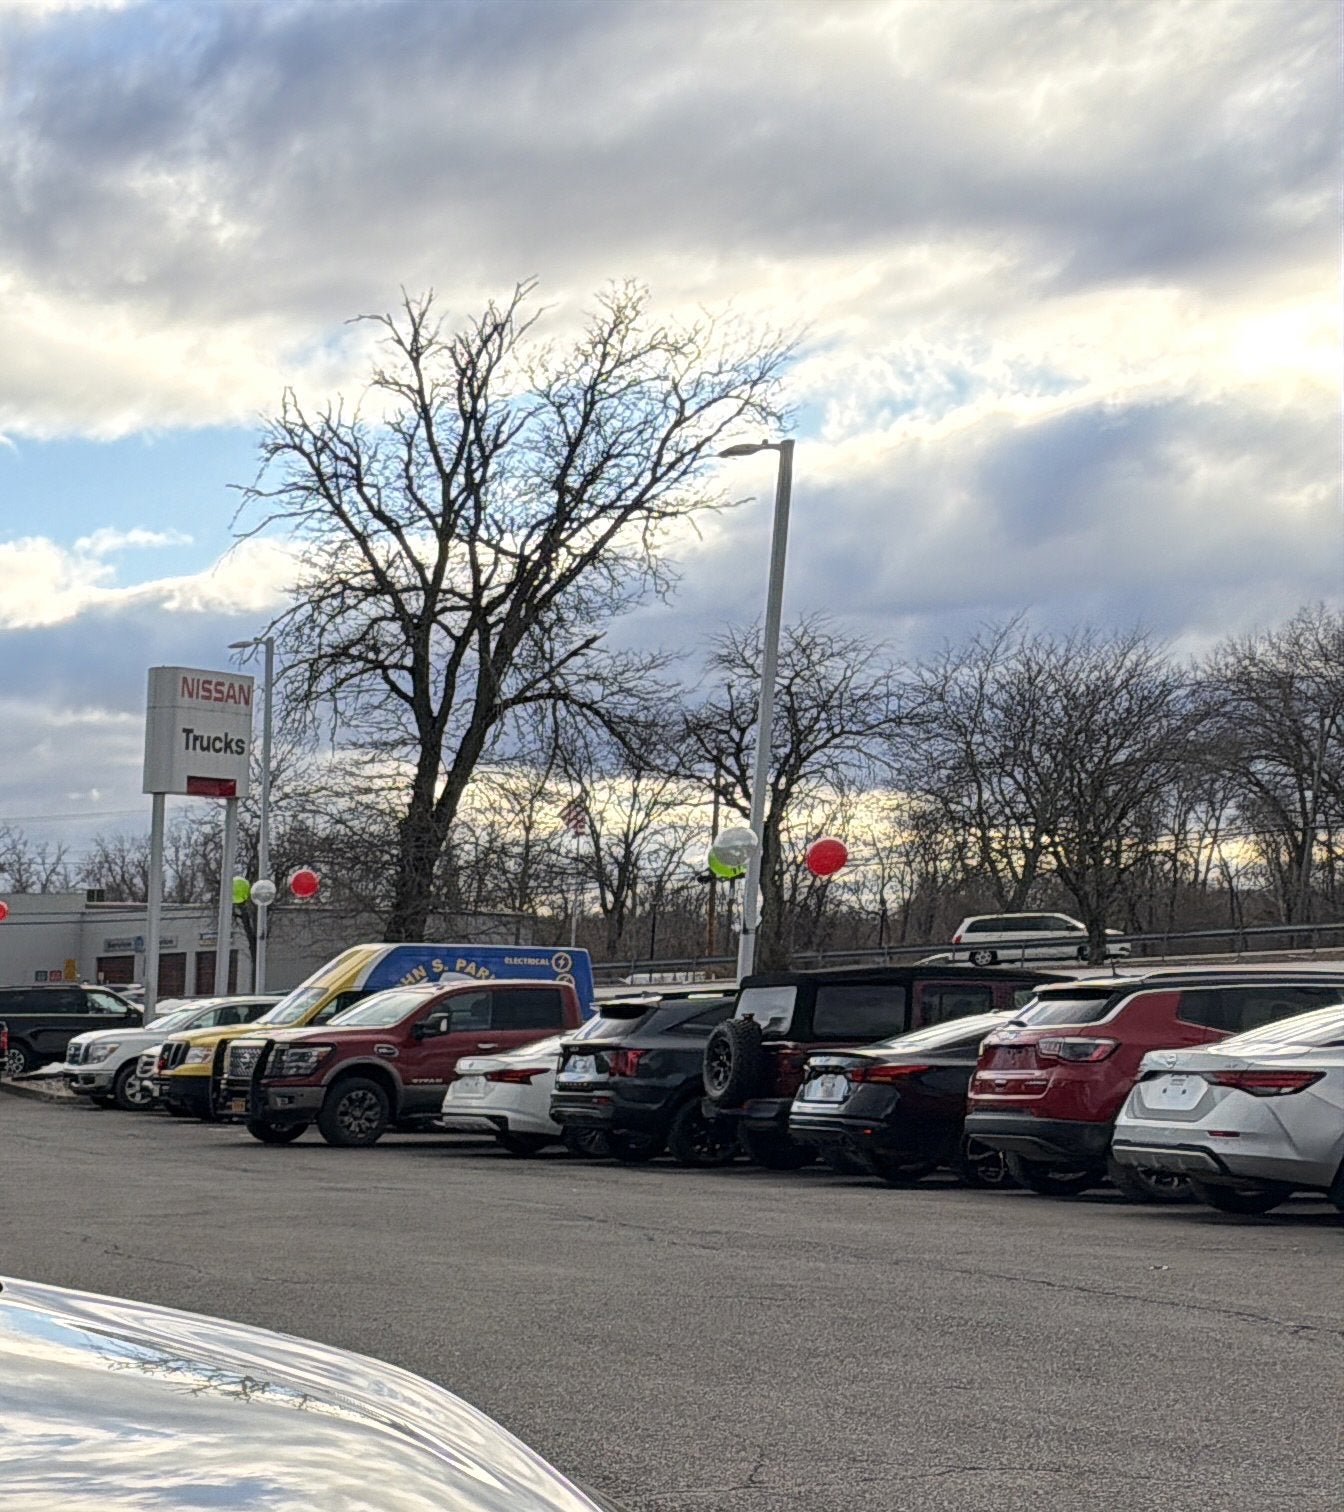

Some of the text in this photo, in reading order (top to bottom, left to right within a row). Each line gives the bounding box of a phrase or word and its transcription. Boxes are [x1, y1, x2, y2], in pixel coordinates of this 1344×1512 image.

[181, 677, 251, 706] NISSAN
[182, 727, 246, 756] Trucks
[432, 958, 449, 973] S.
[455, 958, 496, 980] PAR
